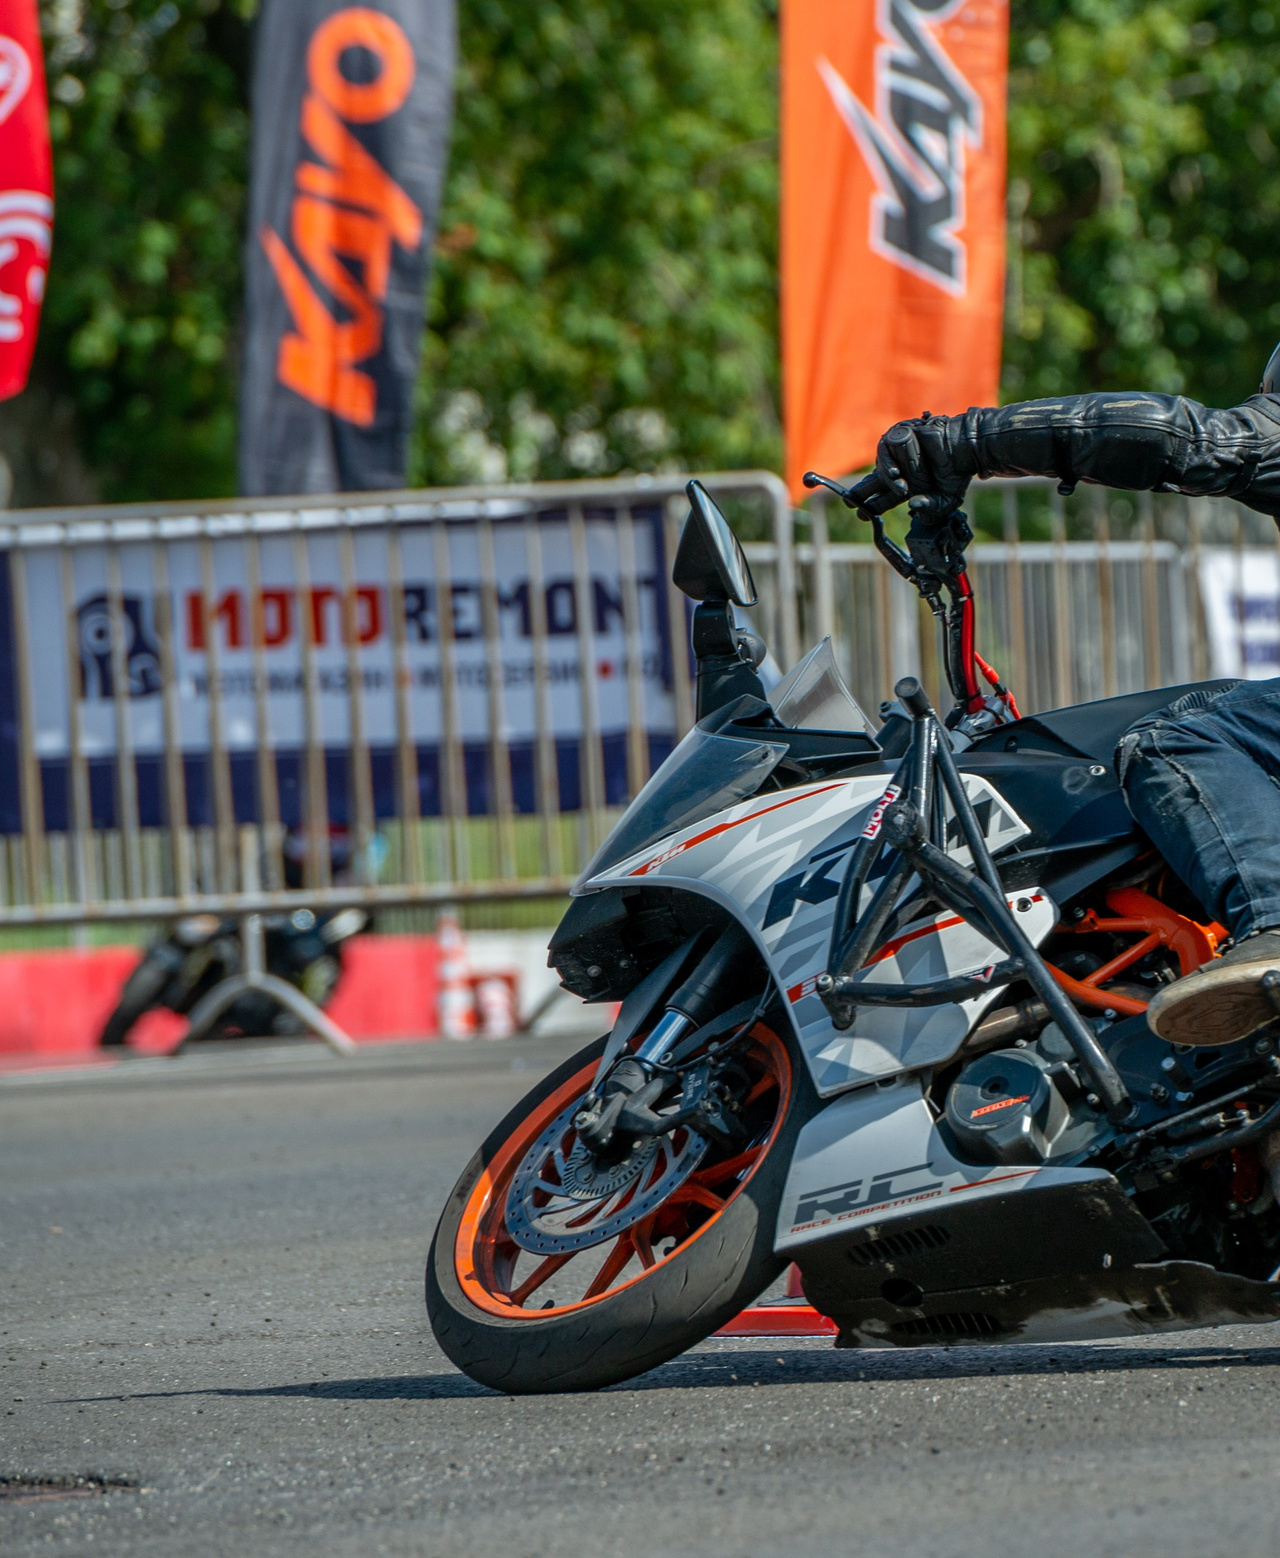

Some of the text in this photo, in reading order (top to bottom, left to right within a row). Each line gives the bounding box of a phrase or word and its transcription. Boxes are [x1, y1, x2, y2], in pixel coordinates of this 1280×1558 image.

[814, 0, 984, 298] KAY
[646, 843, 687, 873] KTM
[790, 1190, 942, 1233] RACE COMPETITION
[793, 1161, 944, 1225] RC
